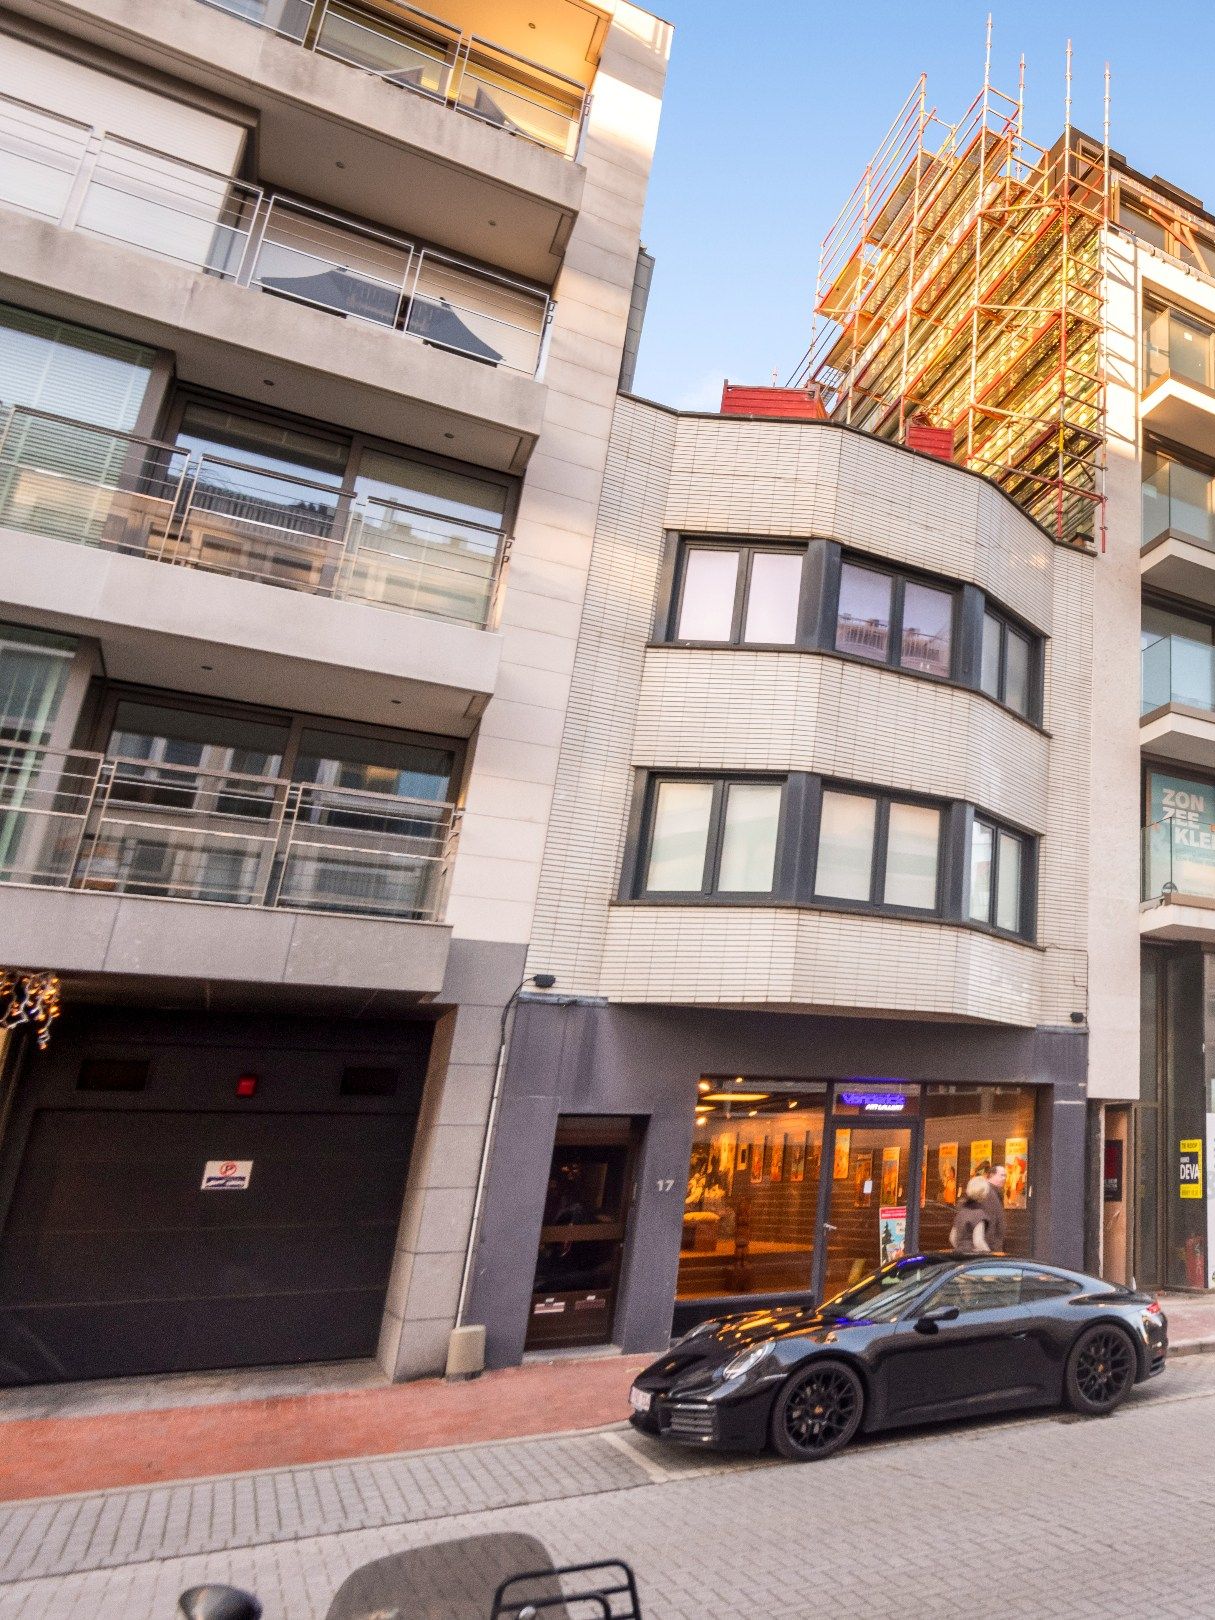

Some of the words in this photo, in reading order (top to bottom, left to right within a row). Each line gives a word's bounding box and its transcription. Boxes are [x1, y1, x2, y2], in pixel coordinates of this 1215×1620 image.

[1162, 788, 1205, 812] ZON
[1162, 806, 1200, 829] ZEE
[1180, 1163, 1200, 1180] DEVA
[657, 1179, 675, 1191] 17
